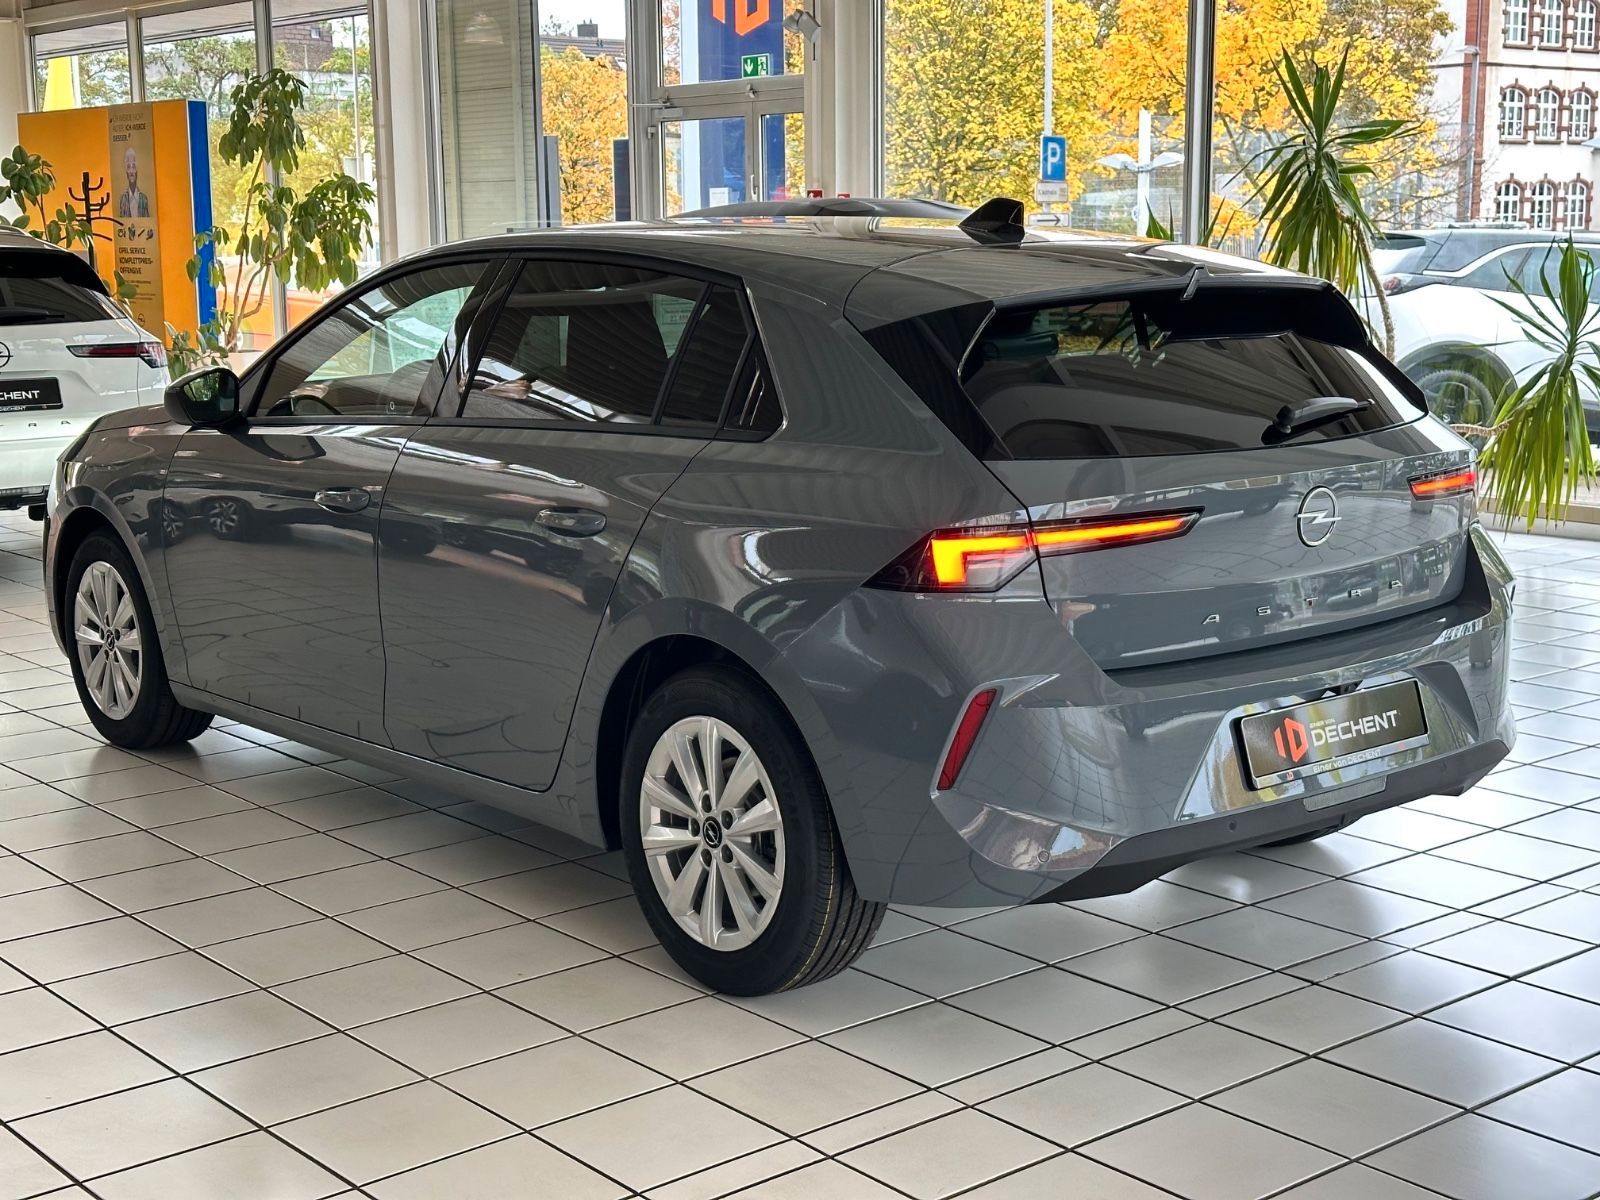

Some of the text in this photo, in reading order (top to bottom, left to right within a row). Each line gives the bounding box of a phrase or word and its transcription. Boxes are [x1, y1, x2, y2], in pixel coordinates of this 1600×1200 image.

[1047, 142, 1060, 175] P
[120, 266, 142, 274] OFFENSIVE
[1311, 709, 1398, 747] DECHENT
[1312, 763, 1332, 774] Einer
[1333, 759, 1348, 768] von
[1347, 749, 1381, 765] DECHENT
